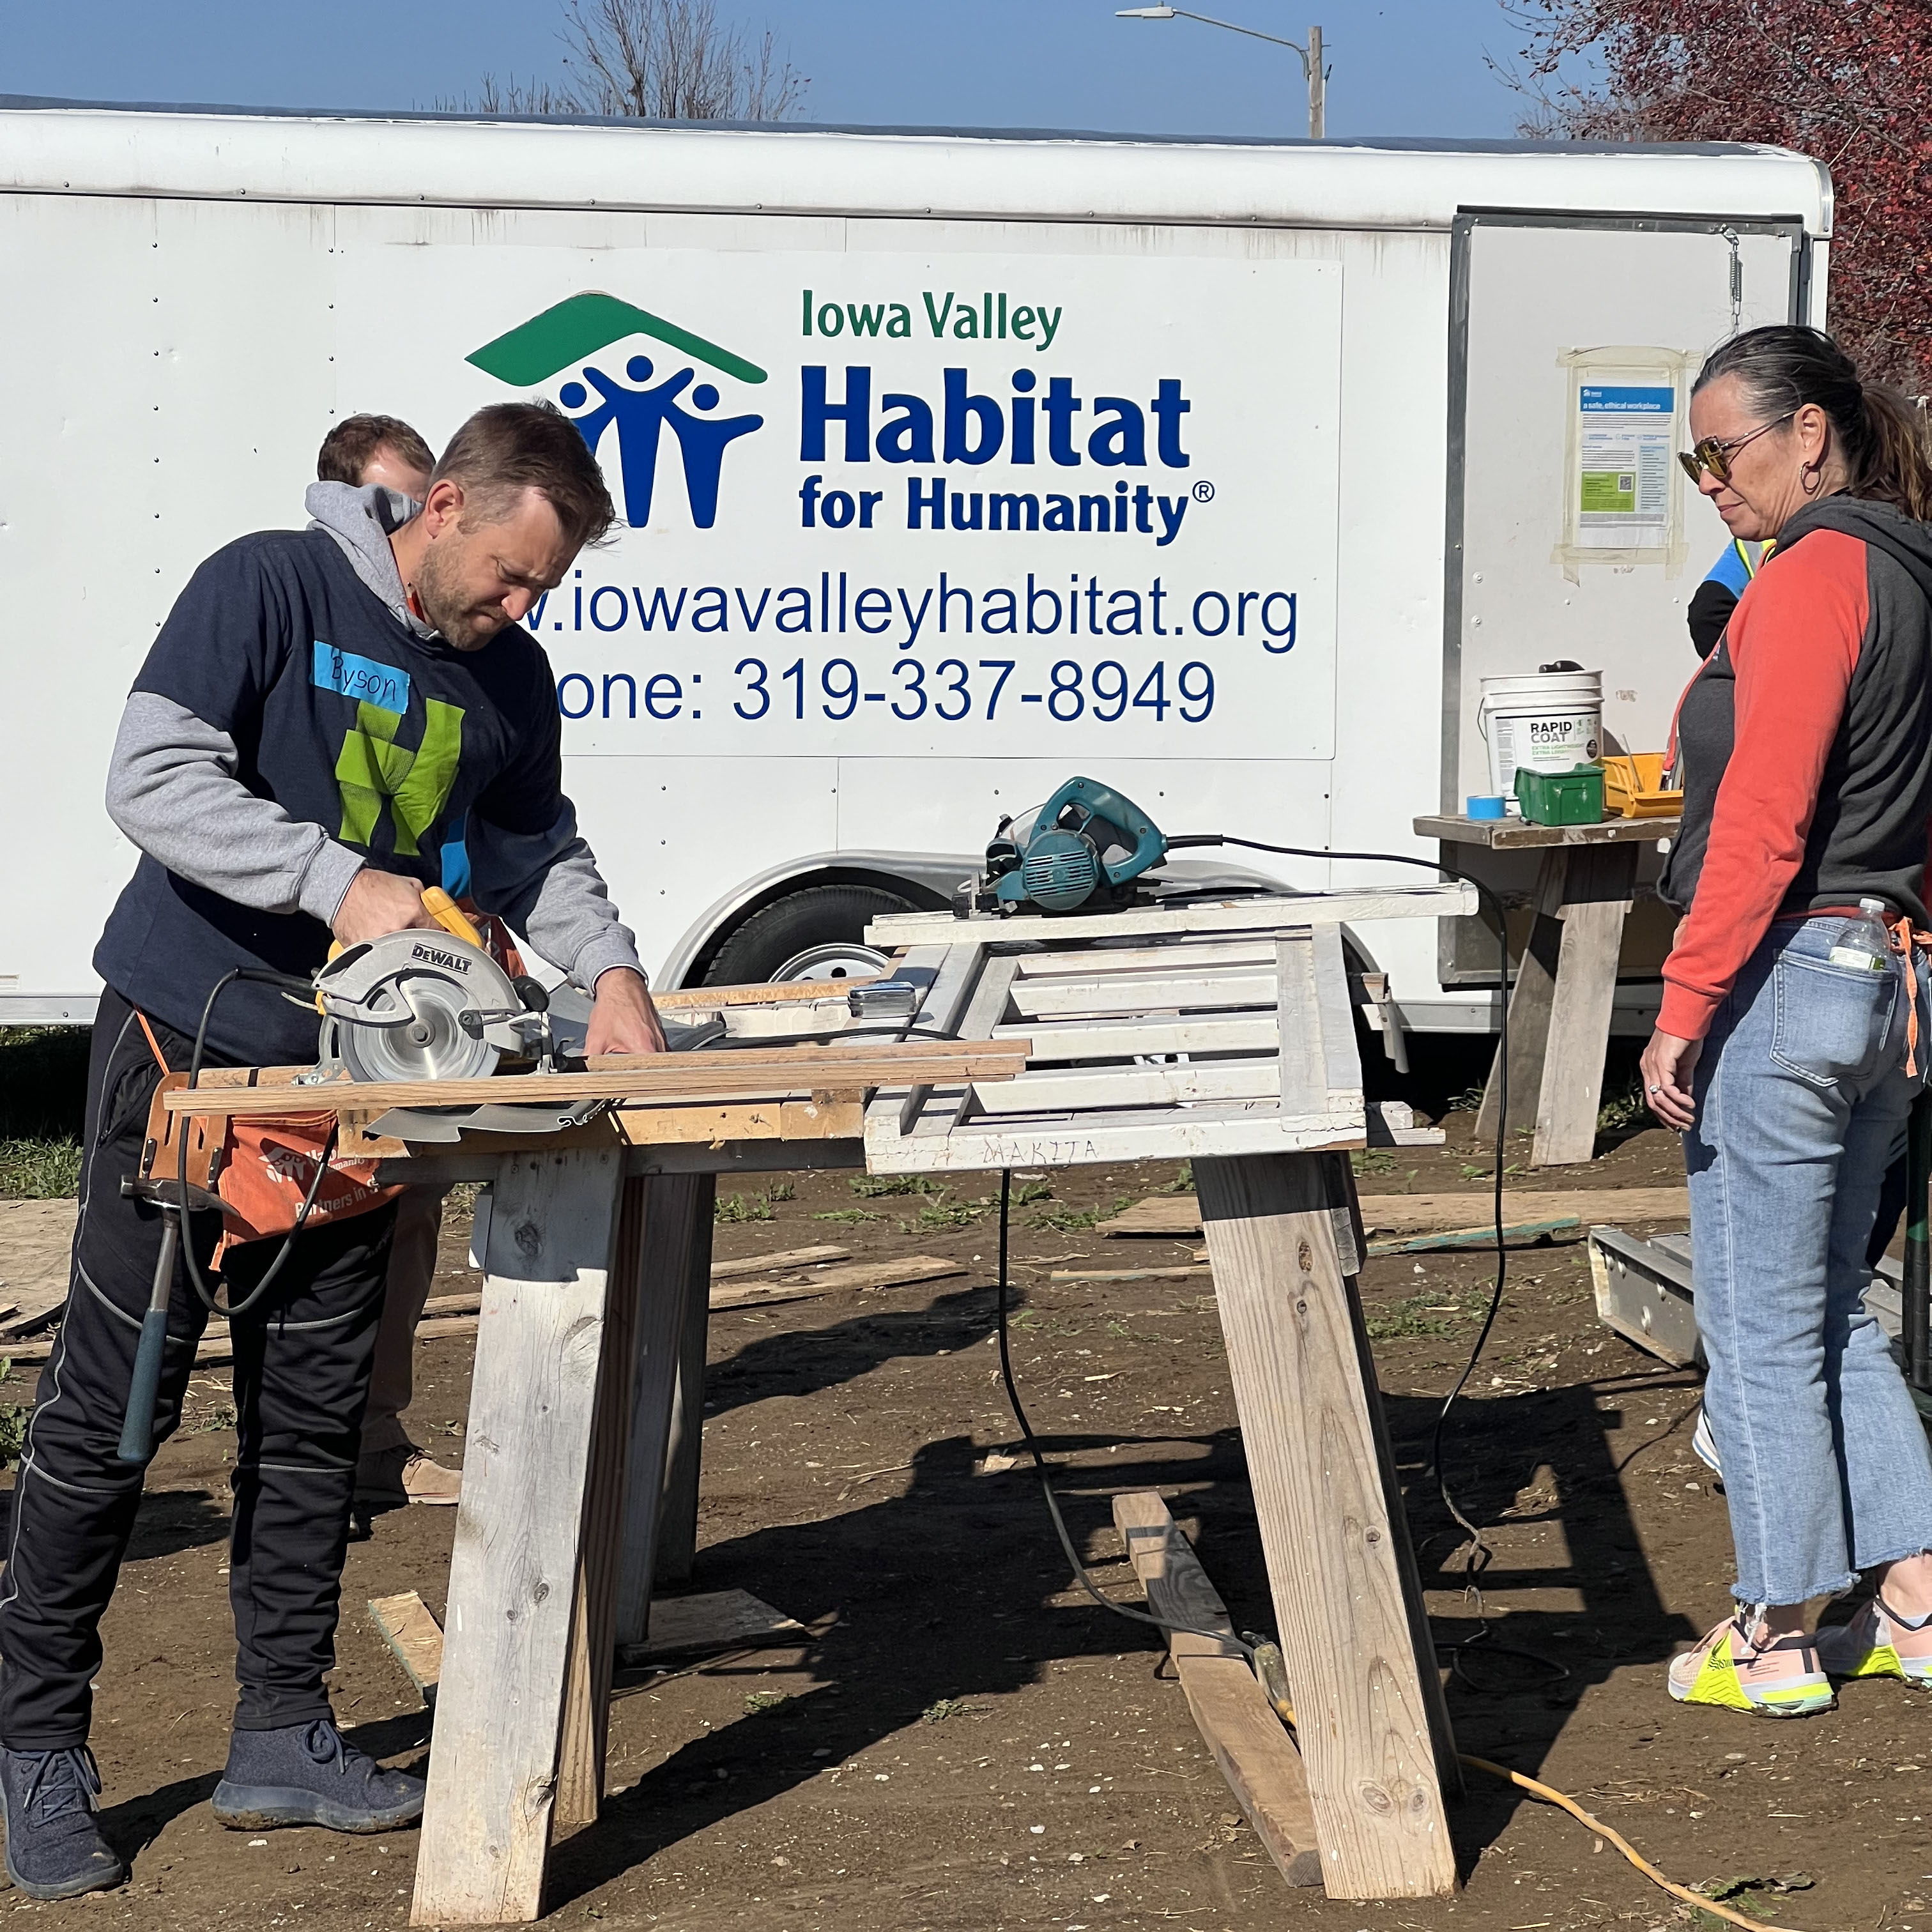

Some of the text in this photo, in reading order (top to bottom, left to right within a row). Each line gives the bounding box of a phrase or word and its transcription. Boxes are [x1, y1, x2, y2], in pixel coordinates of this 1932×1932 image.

[802, 289, 1062, 351] Iowa Valley
[800, 365, 1191, 468] Habitat
[1605, 401, 1627, 410] ethical
[1627, 402, 1661, 410] workplace
[799, 475, 883, 529] for
[332, 656, 397, 702] Byson
[557, 657, 1216, 723] one: 319-337-8949
[1530, 721, 1572, 733] RAPID
[1531, 732, 1570, 743] COAT
[353, 1187, 367, 1202] in
